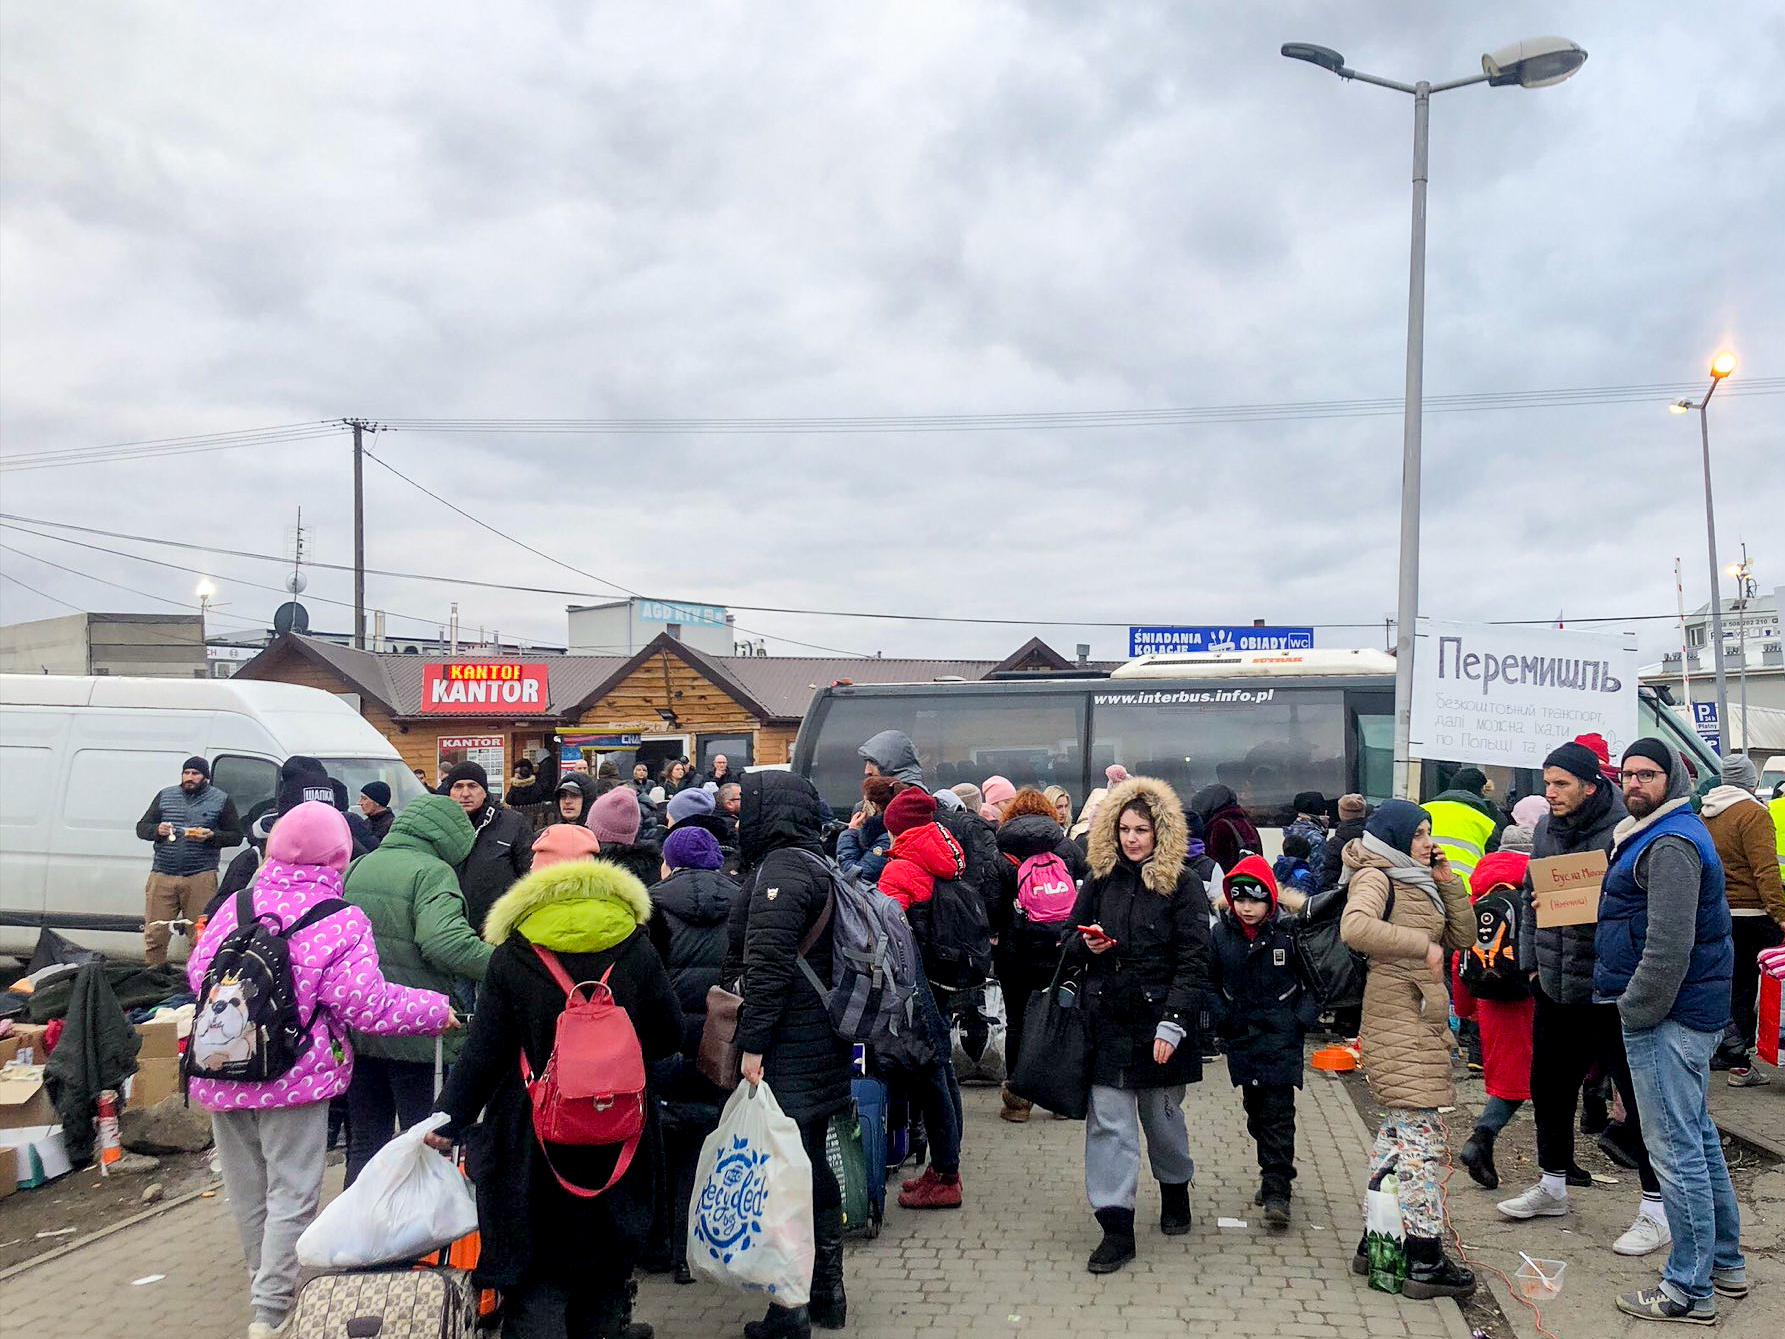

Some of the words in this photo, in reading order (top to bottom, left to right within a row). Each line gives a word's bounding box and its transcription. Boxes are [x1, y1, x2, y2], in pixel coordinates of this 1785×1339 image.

[642, 602, 673, 620] AGD
[1134, 629, 1202, 644] ŚNIADANIA
[1240, 637, 1288, 650] OBIADY
[1290, 639, 1309, 649] WC
[1135, 645, 1189, 656] KOLACJE
[1438, 636, 1622, 695] Перемишль
[431, 679, 539, 703] KANTOR
[1094, 689, 1275, 704] www.interbus.info.pl
[1698, 704, 1711, 721] P
[1476, 718, 1525, 734] можна
[442, 738, 501, 748] KANTOR
[1436, 734, 1454, 746] по
[1522, 741, 1537, 754] та
[305, 789, 334, 802] ШАПКА
[1032, 881, 1069, 896] FILA
